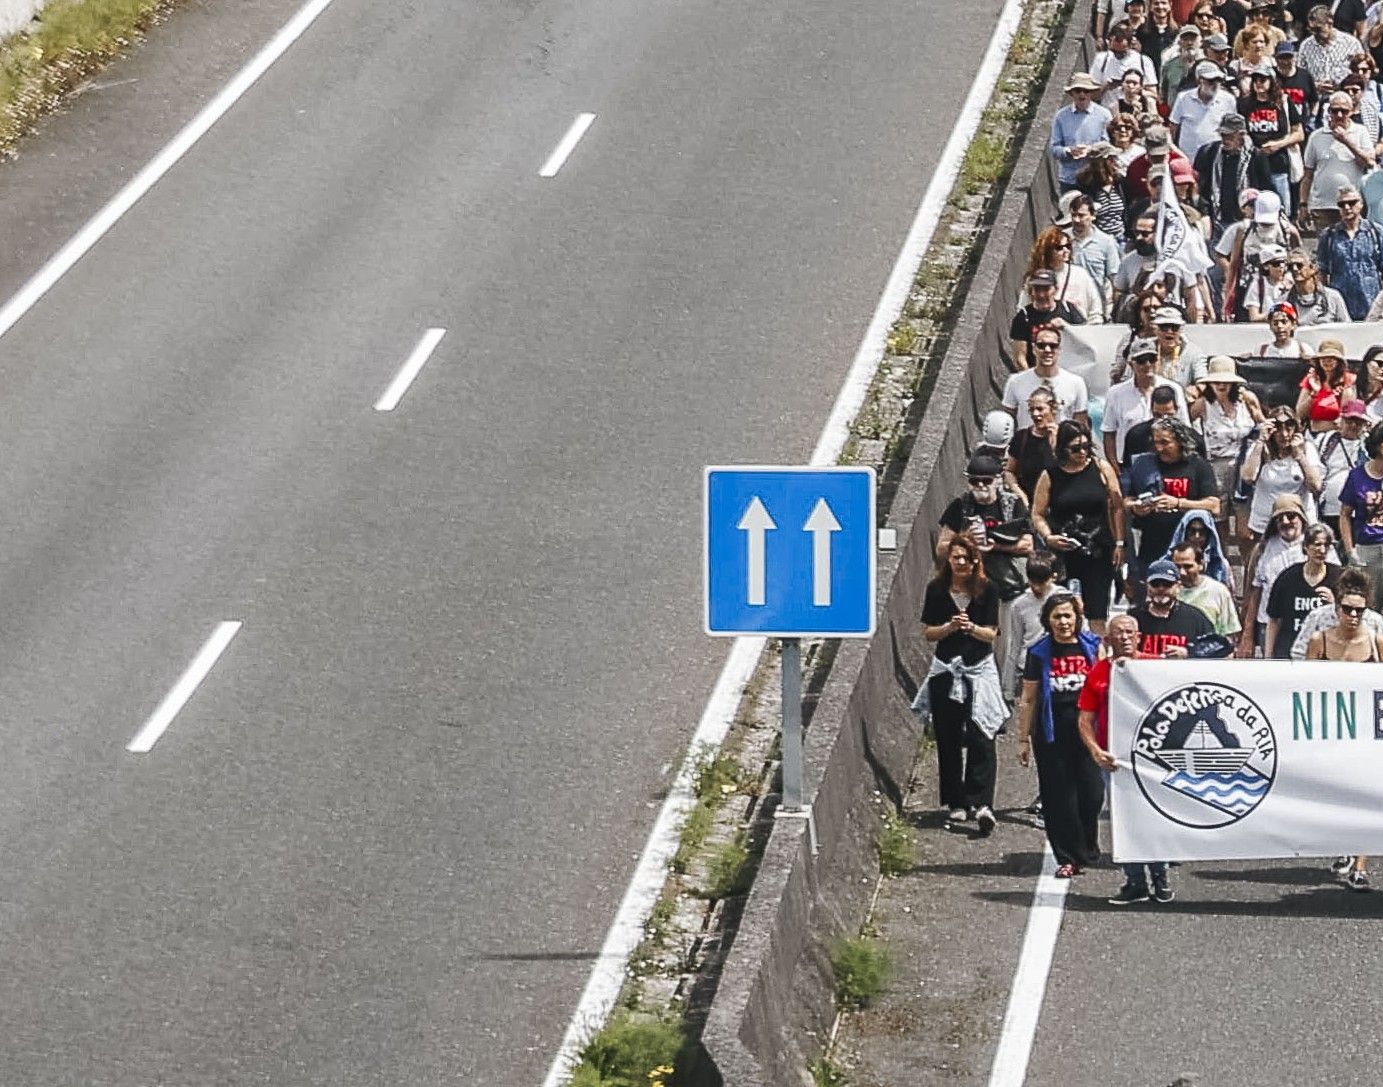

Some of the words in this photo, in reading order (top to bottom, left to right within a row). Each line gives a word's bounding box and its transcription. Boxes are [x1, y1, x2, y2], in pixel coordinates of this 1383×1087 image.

[1158, 687, 1236, 722] Defensa
[1235, 704, 1259, 730] da
[1292, 691, 1357, 741] NIN
